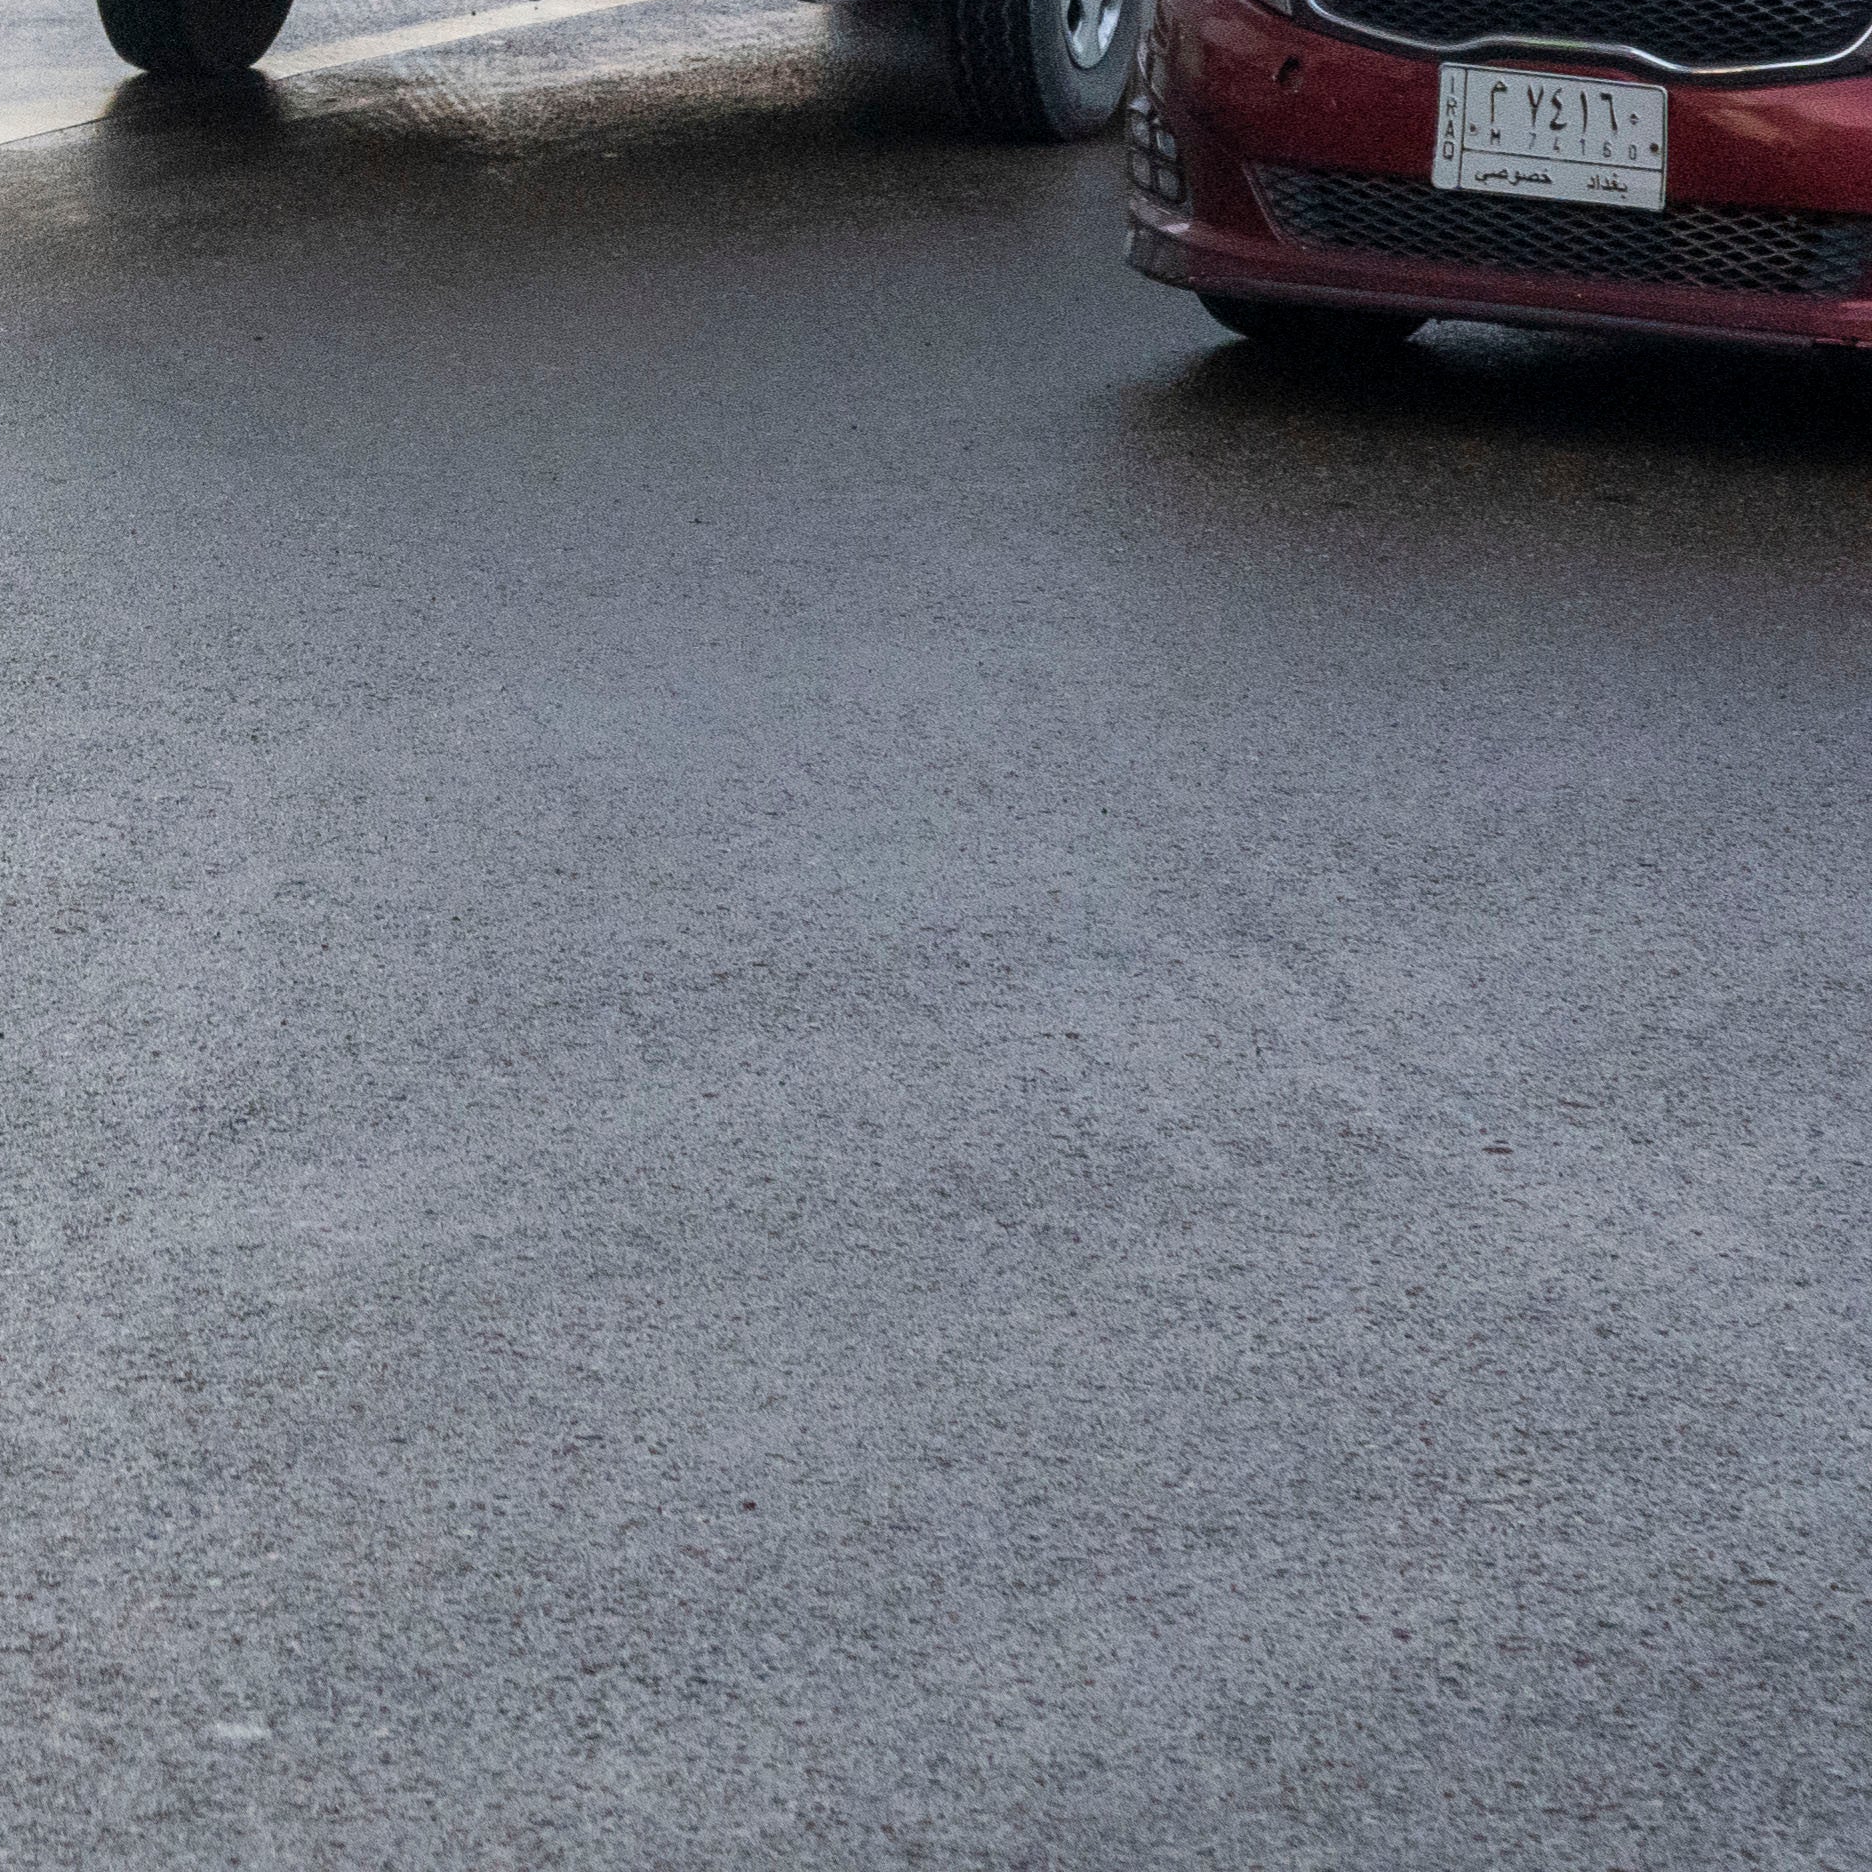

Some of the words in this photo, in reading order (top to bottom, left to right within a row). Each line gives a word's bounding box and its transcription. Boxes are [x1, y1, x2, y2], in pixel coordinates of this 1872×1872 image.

[1443, 76, 1457, 160] IRAQ
[1527, 85, 1639, 133] ٧٤١٦٠
[1475, 168, 1553, 187] خصوصي
[1587, 172, 1628, 199] بغداد
